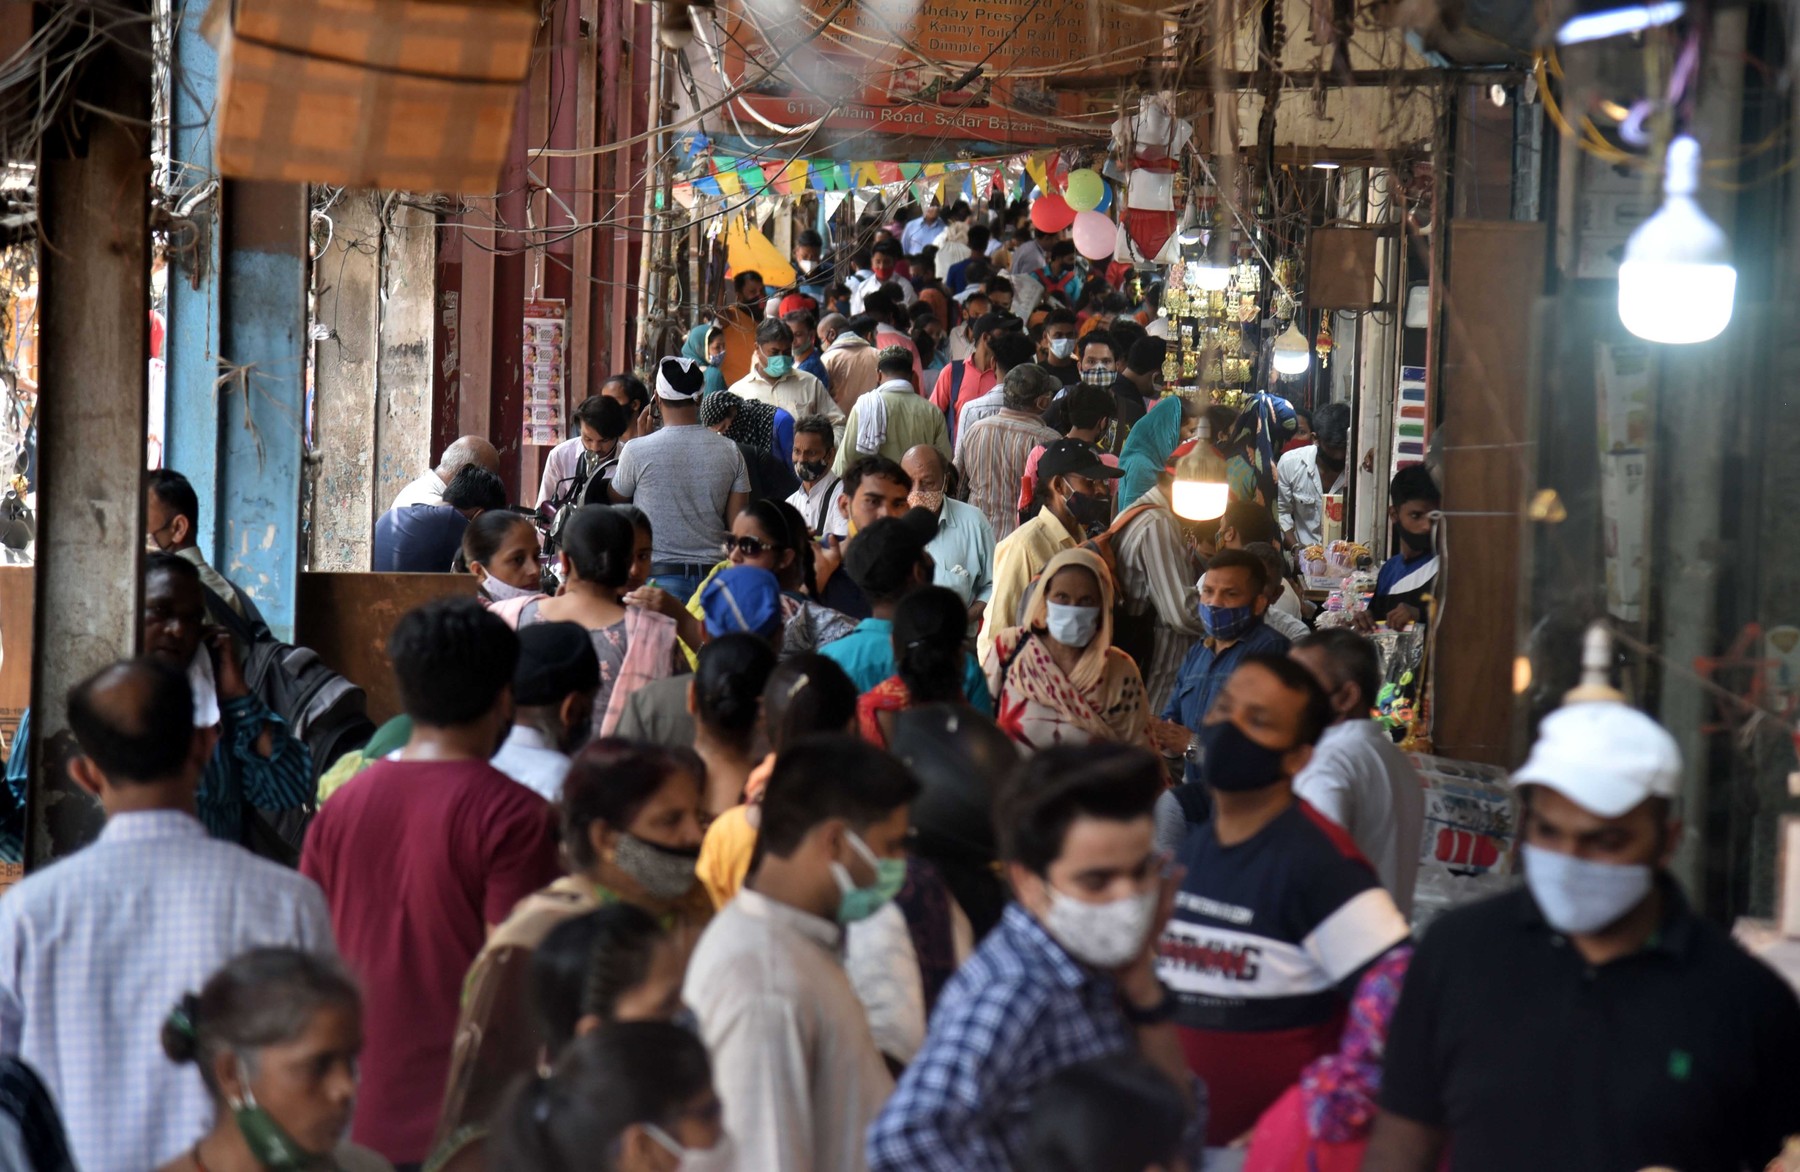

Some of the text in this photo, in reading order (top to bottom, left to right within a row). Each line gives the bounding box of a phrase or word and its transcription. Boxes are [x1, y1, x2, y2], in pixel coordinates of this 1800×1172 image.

[929, 21, 975, 37] Kanny
[929, 39, 981, 54] Dimple
[836, 106, 875, 120] Main
[935, 112, 983, 129] Sadar
